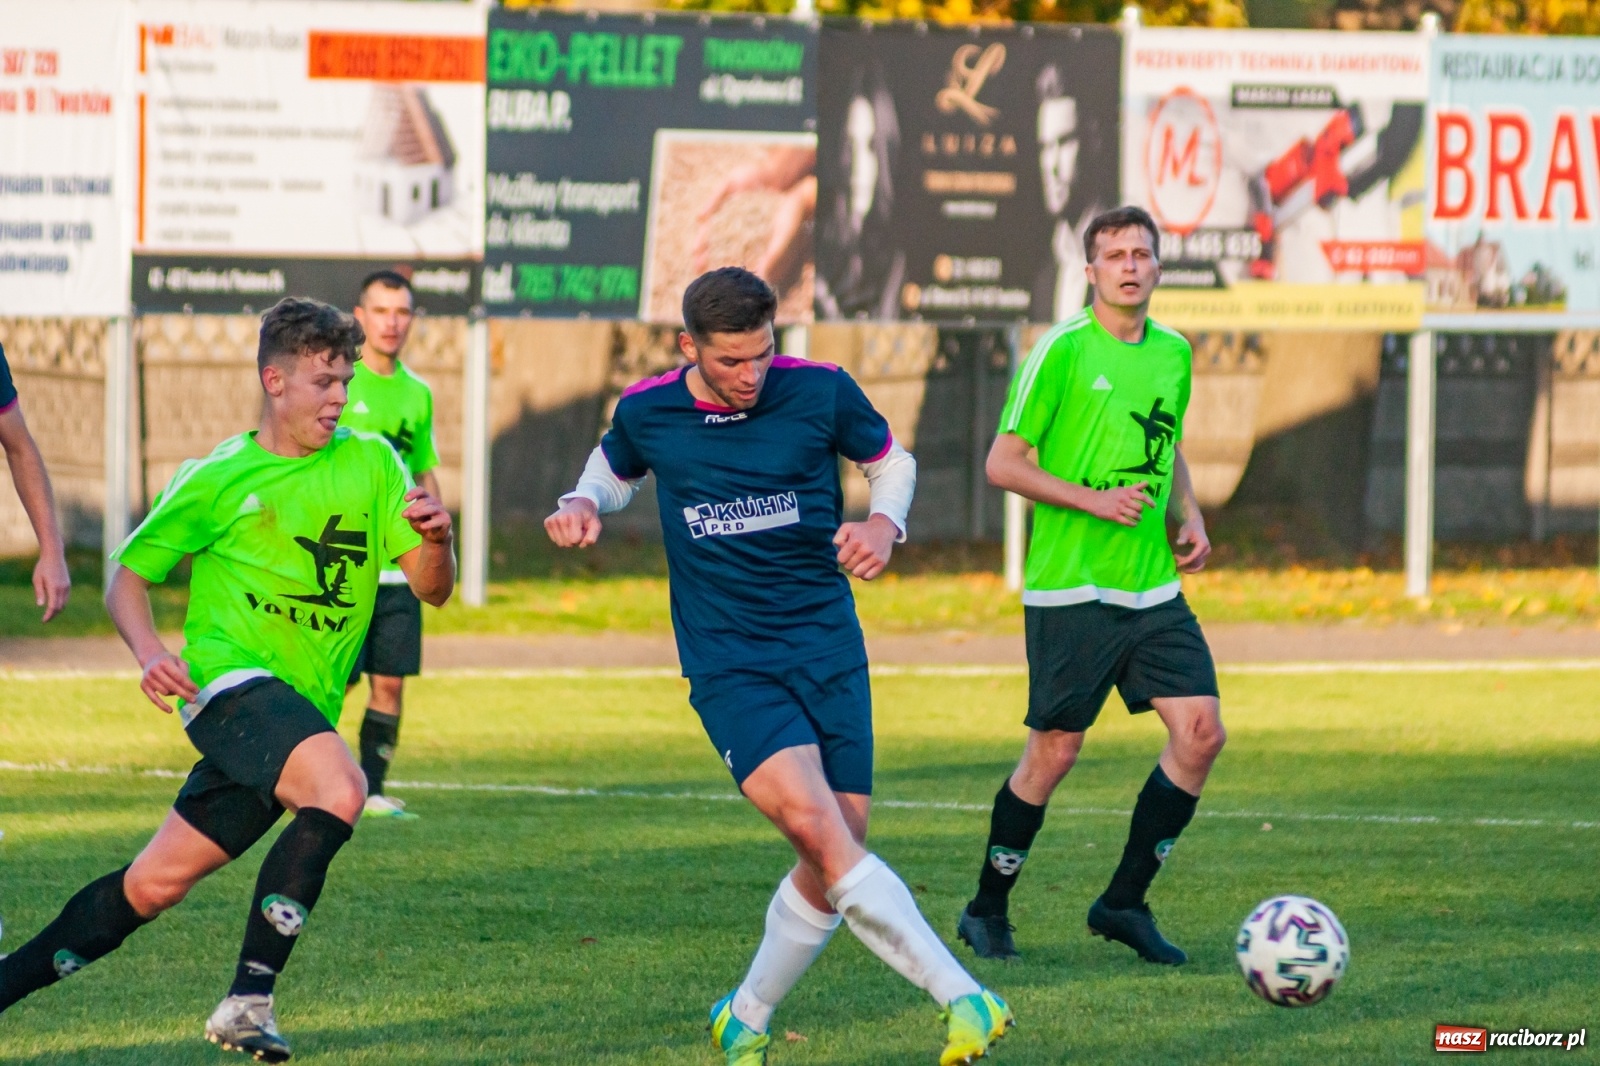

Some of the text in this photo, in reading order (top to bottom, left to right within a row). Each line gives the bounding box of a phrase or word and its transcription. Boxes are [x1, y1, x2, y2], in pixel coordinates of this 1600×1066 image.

[489, 28, 684, 87] EKO-PELLET
[1443, 52, 1567, 80] RESTAURACJA
[1433, 112, 1600, 221] BRA
[714, 491, 798, 521] KÜHN
[711, 522, 745, 532] PRD
